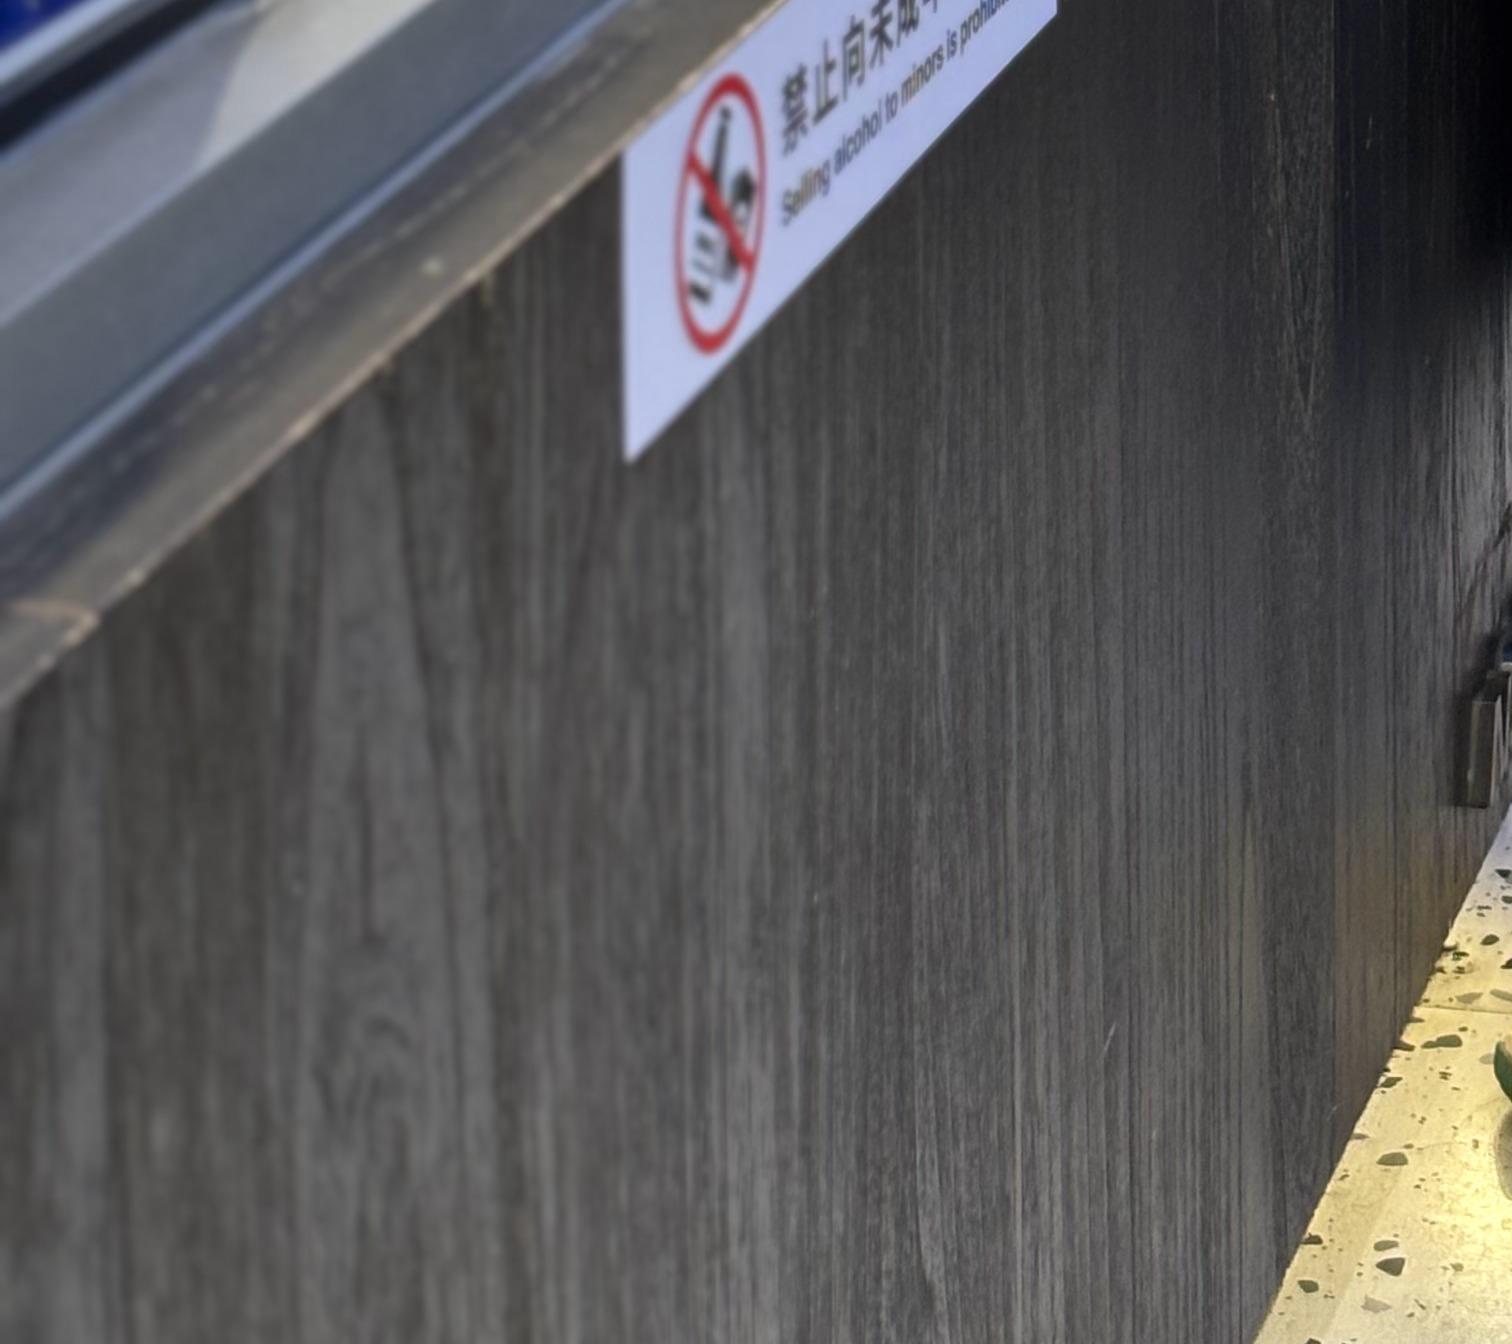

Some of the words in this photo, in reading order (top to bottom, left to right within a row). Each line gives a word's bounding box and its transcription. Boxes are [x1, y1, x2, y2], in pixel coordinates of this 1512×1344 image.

[782, 159, 832, 228] Selling
[834, 98, 883, 175] alcohol
[885, 89, 898, 123] to
[901, 43, 945, 108] minors
[946, 27, 958, 61] is
